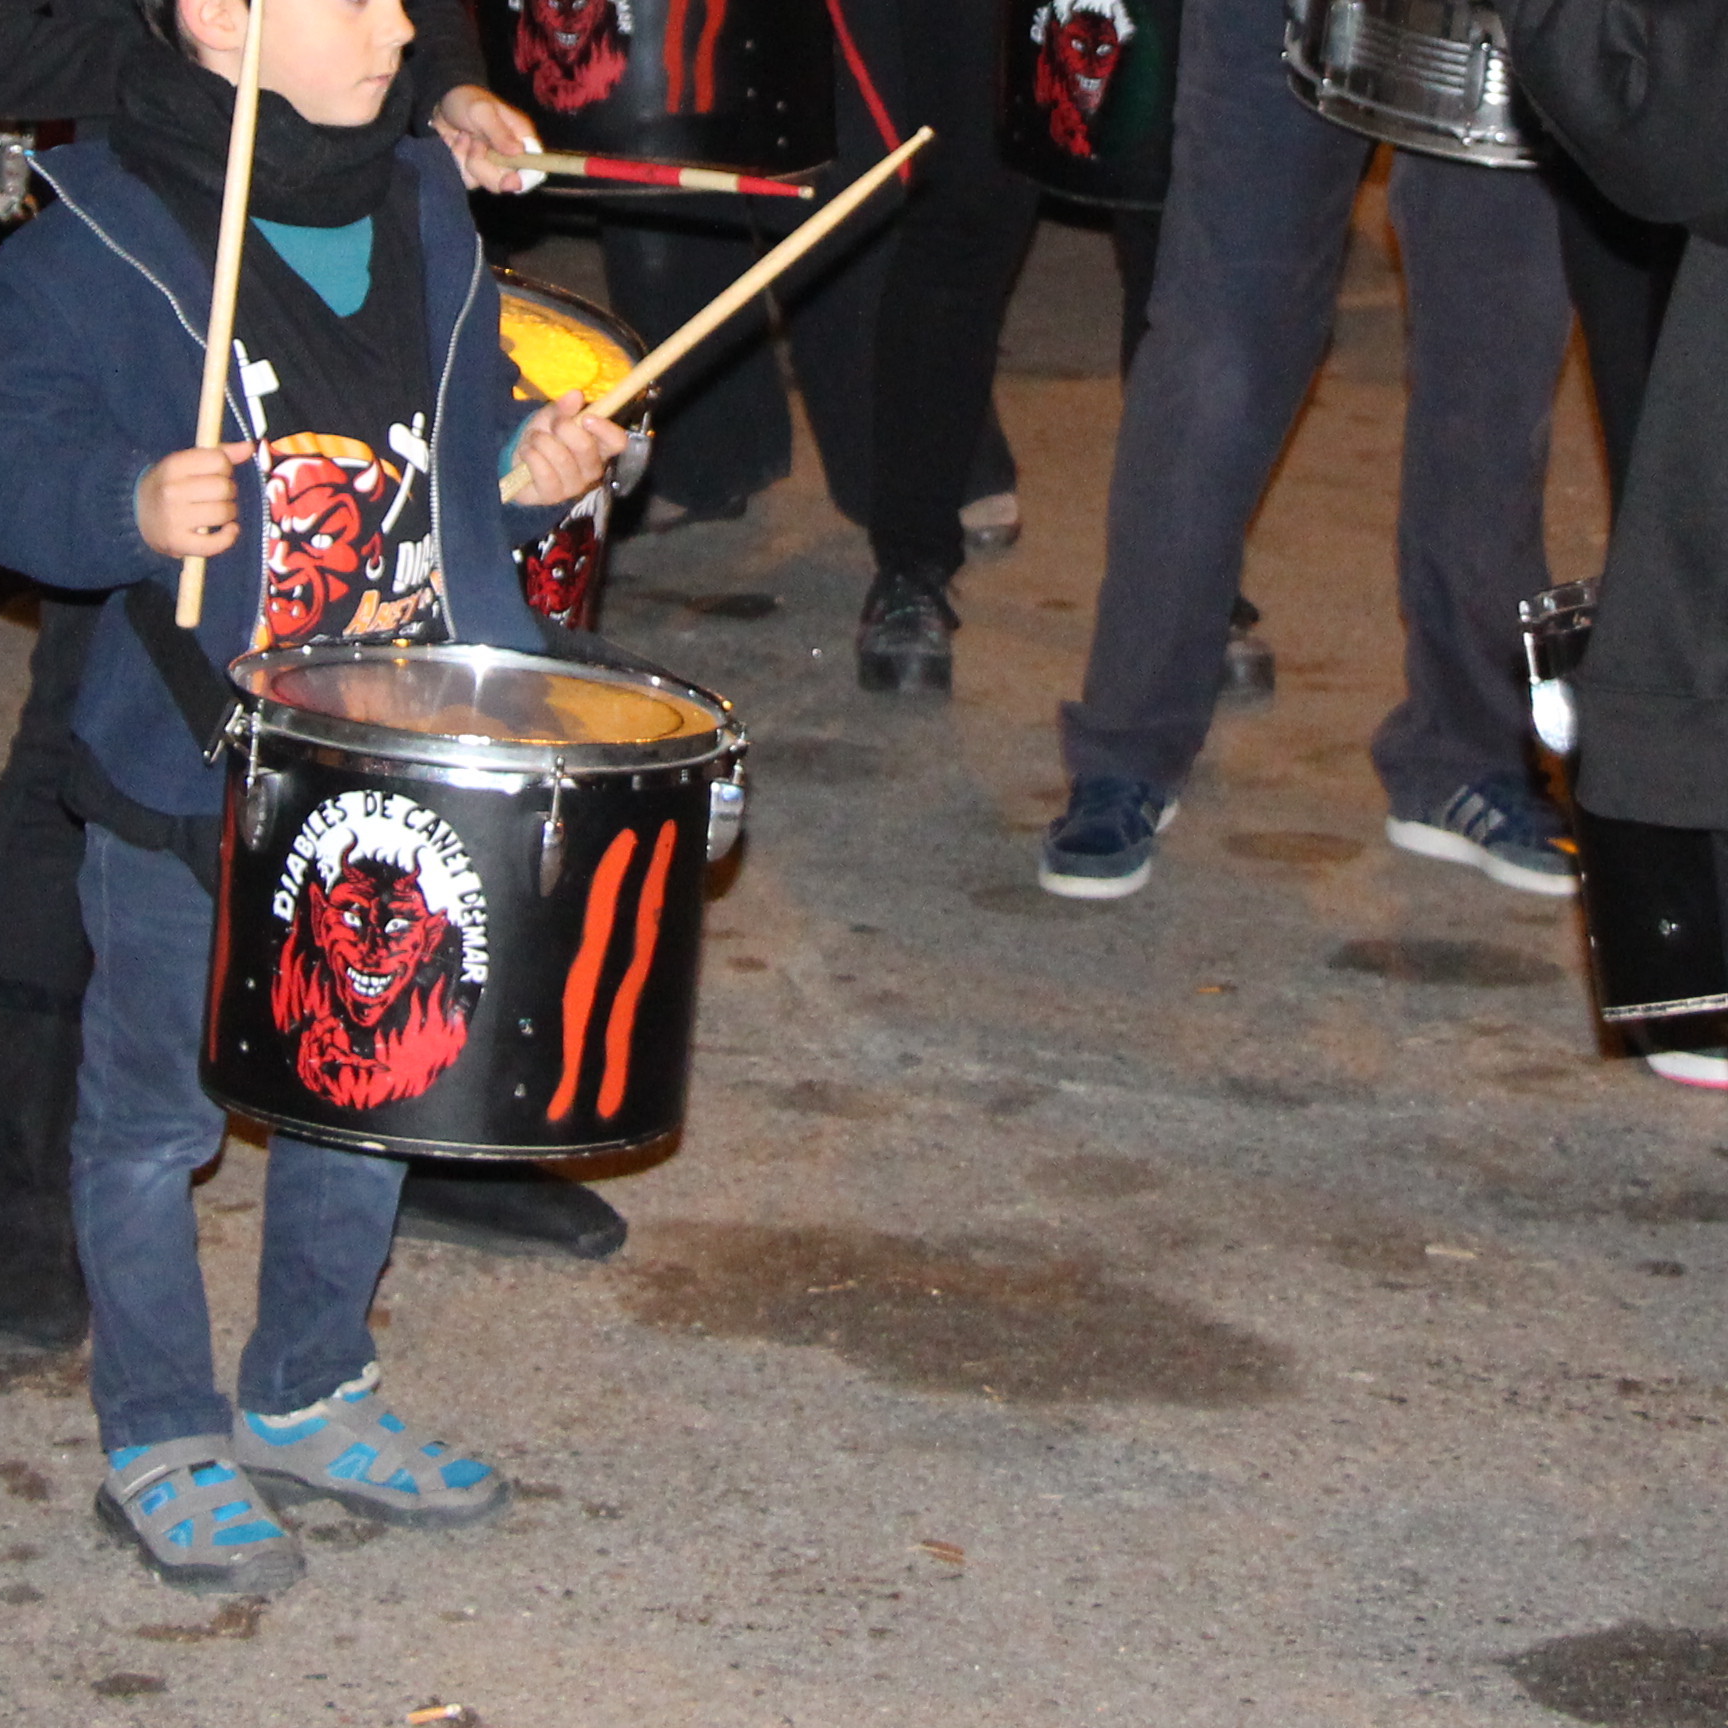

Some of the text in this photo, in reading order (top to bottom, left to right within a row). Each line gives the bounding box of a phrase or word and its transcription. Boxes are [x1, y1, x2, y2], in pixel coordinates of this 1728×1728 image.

[272, 797, 348, 922] DIABLES
[363, 790, 394, 820] DE
[404, 804, 471, 878] CANET
